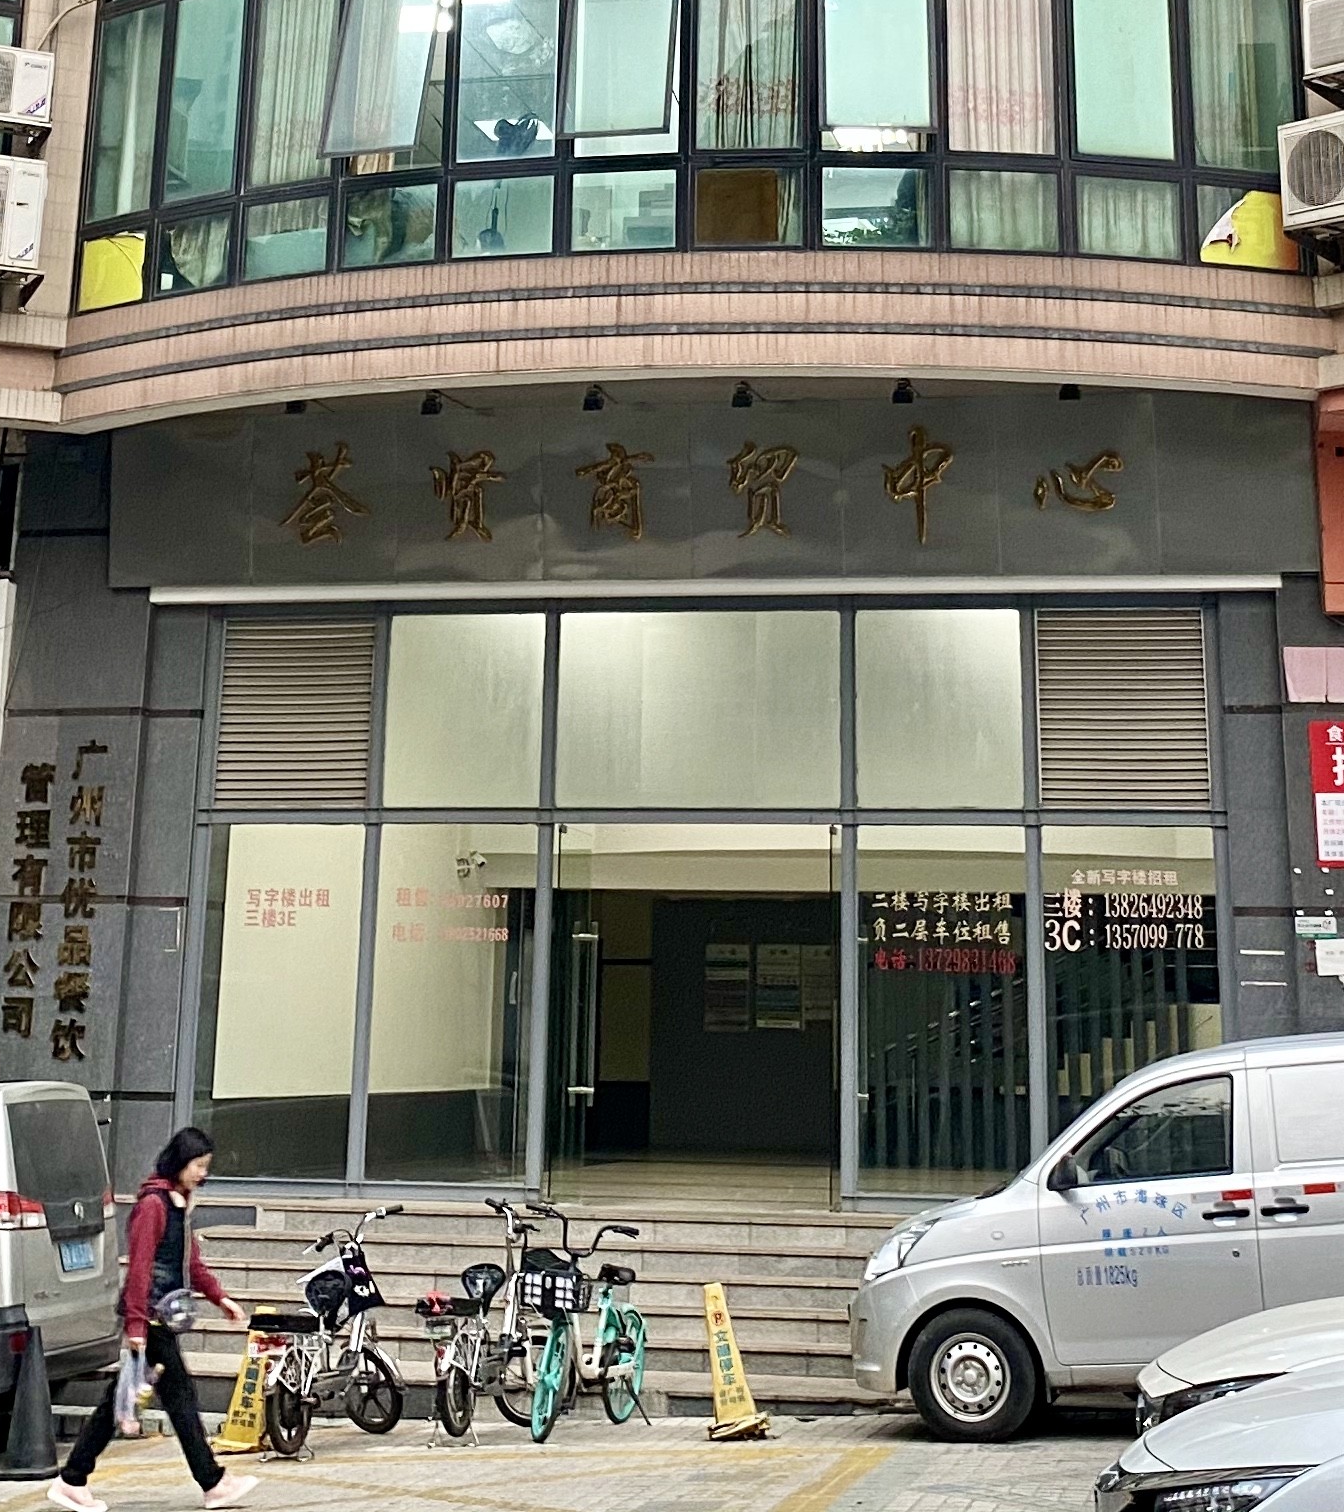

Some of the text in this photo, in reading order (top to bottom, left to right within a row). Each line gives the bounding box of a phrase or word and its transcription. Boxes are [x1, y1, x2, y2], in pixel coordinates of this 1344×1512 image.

[279, 423, 1125, 546] 荟贤商贸中心
[1071, 869, 1179, 886] 全新写字楼招租
[2, 762, 56, 1038] 管理有限公司
[246, 888, 331, 908] 写字楼出租
[871, 890, 1014, 915] 二楼写字楼出租
[244, 910, 298, 928] 三楼3E
[872, 917, 1013, 945] 负二层车位租售
